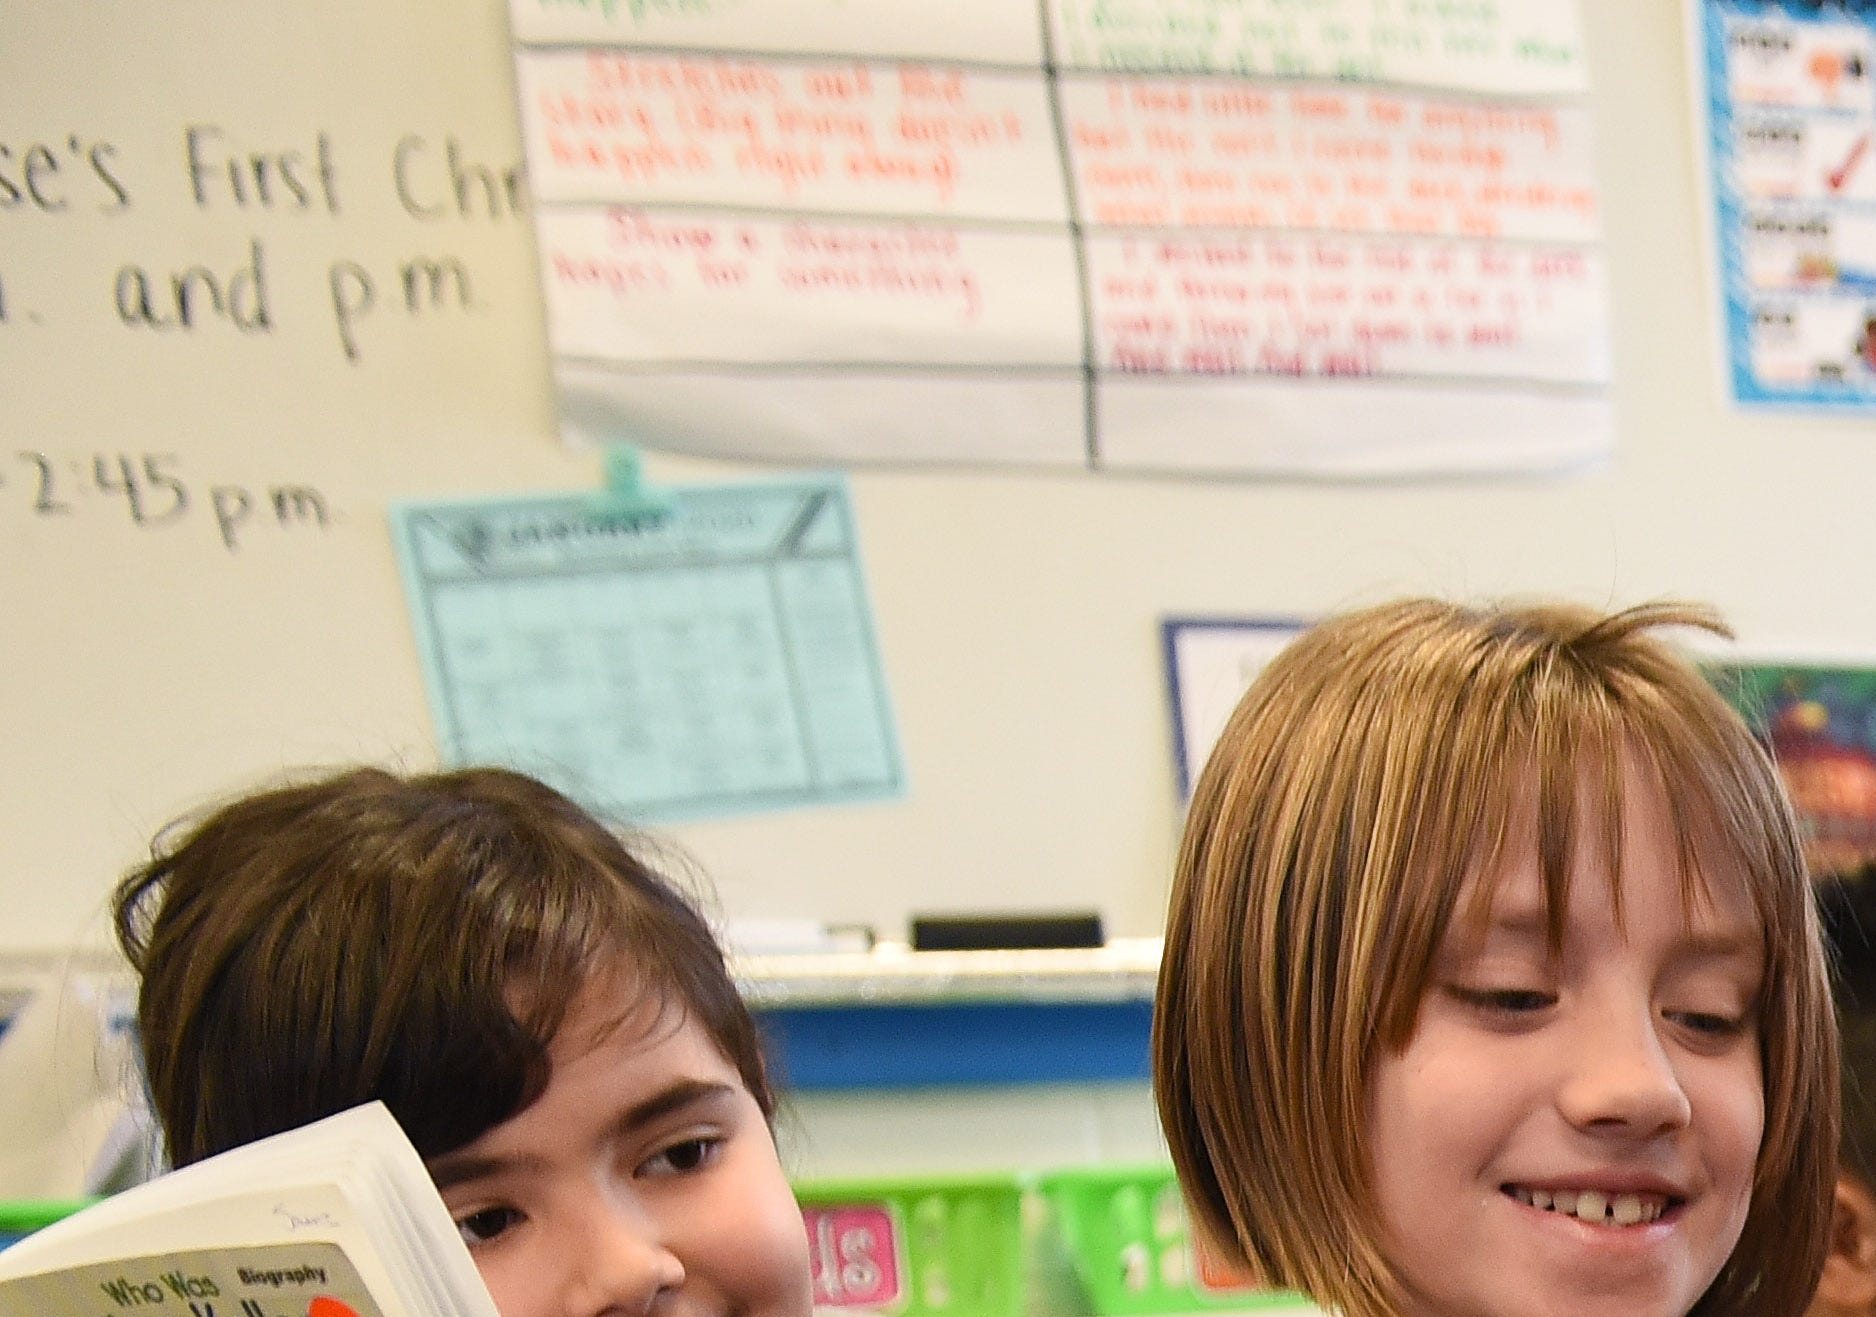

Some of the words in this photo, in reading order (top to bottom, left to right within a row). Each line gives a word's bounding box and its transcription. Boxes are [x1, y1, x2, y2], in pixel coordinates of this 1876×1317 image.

[186, 124, 339, 217] First
[114, 236, 272, 334] and
[101, 1276, 165, 1308] Who
[161, 1269, 221, 1301] Was
[237, 1264, 328, 1287] Biography
